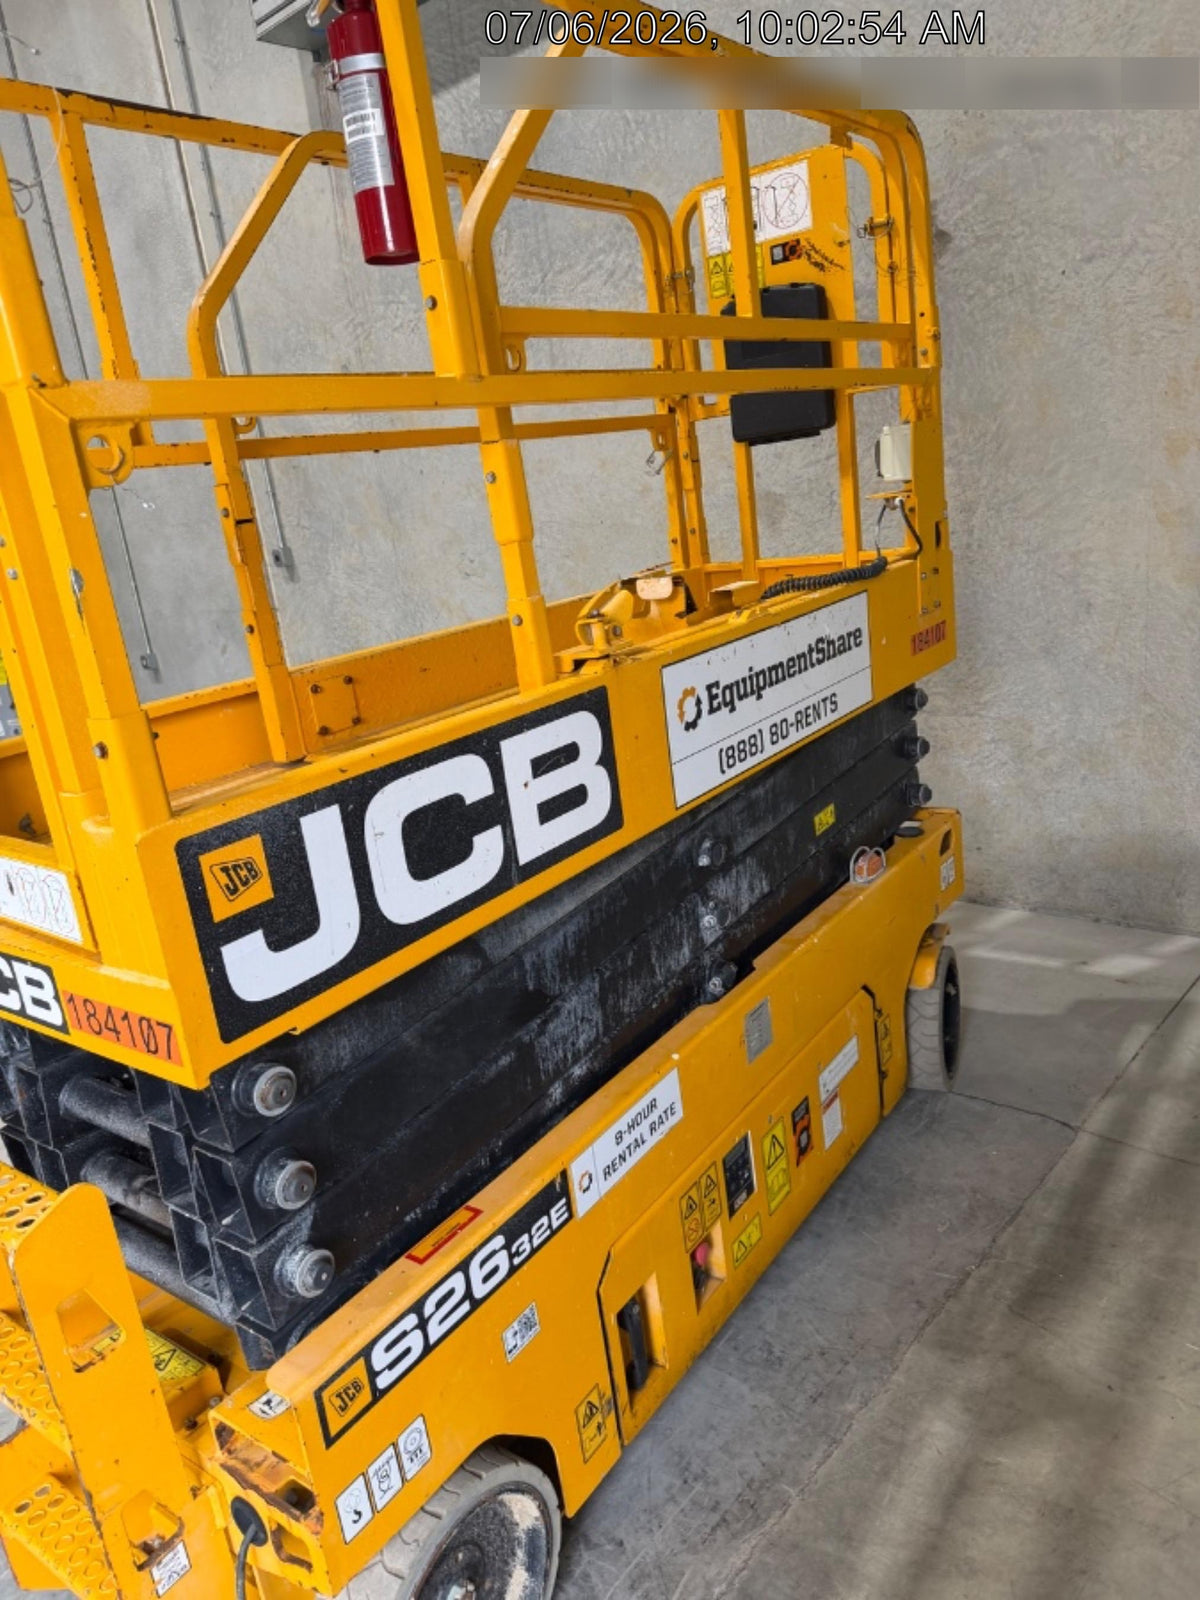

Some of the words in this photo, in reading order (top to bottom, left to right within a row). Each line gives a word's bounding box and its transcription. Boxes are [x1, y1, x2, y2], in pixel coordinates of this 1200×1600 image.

[706, 627, 862, 715] EquipmentShare
[719, 730, 764, 774] (888)
[770, 693, 838, 745] 80-RENTS
[219, 860, 259, 896] JCB
[220, 711, 612, 1002] JCB
[66, 993, 174, 1060] 184107
[602, 1133, 646, 1181] RENTAL
[649, 1101, 676, 1137] RATE
[614, 1098, 657, 1146] 8-HOUR
[331, 1377, 364, 1412] JCB
